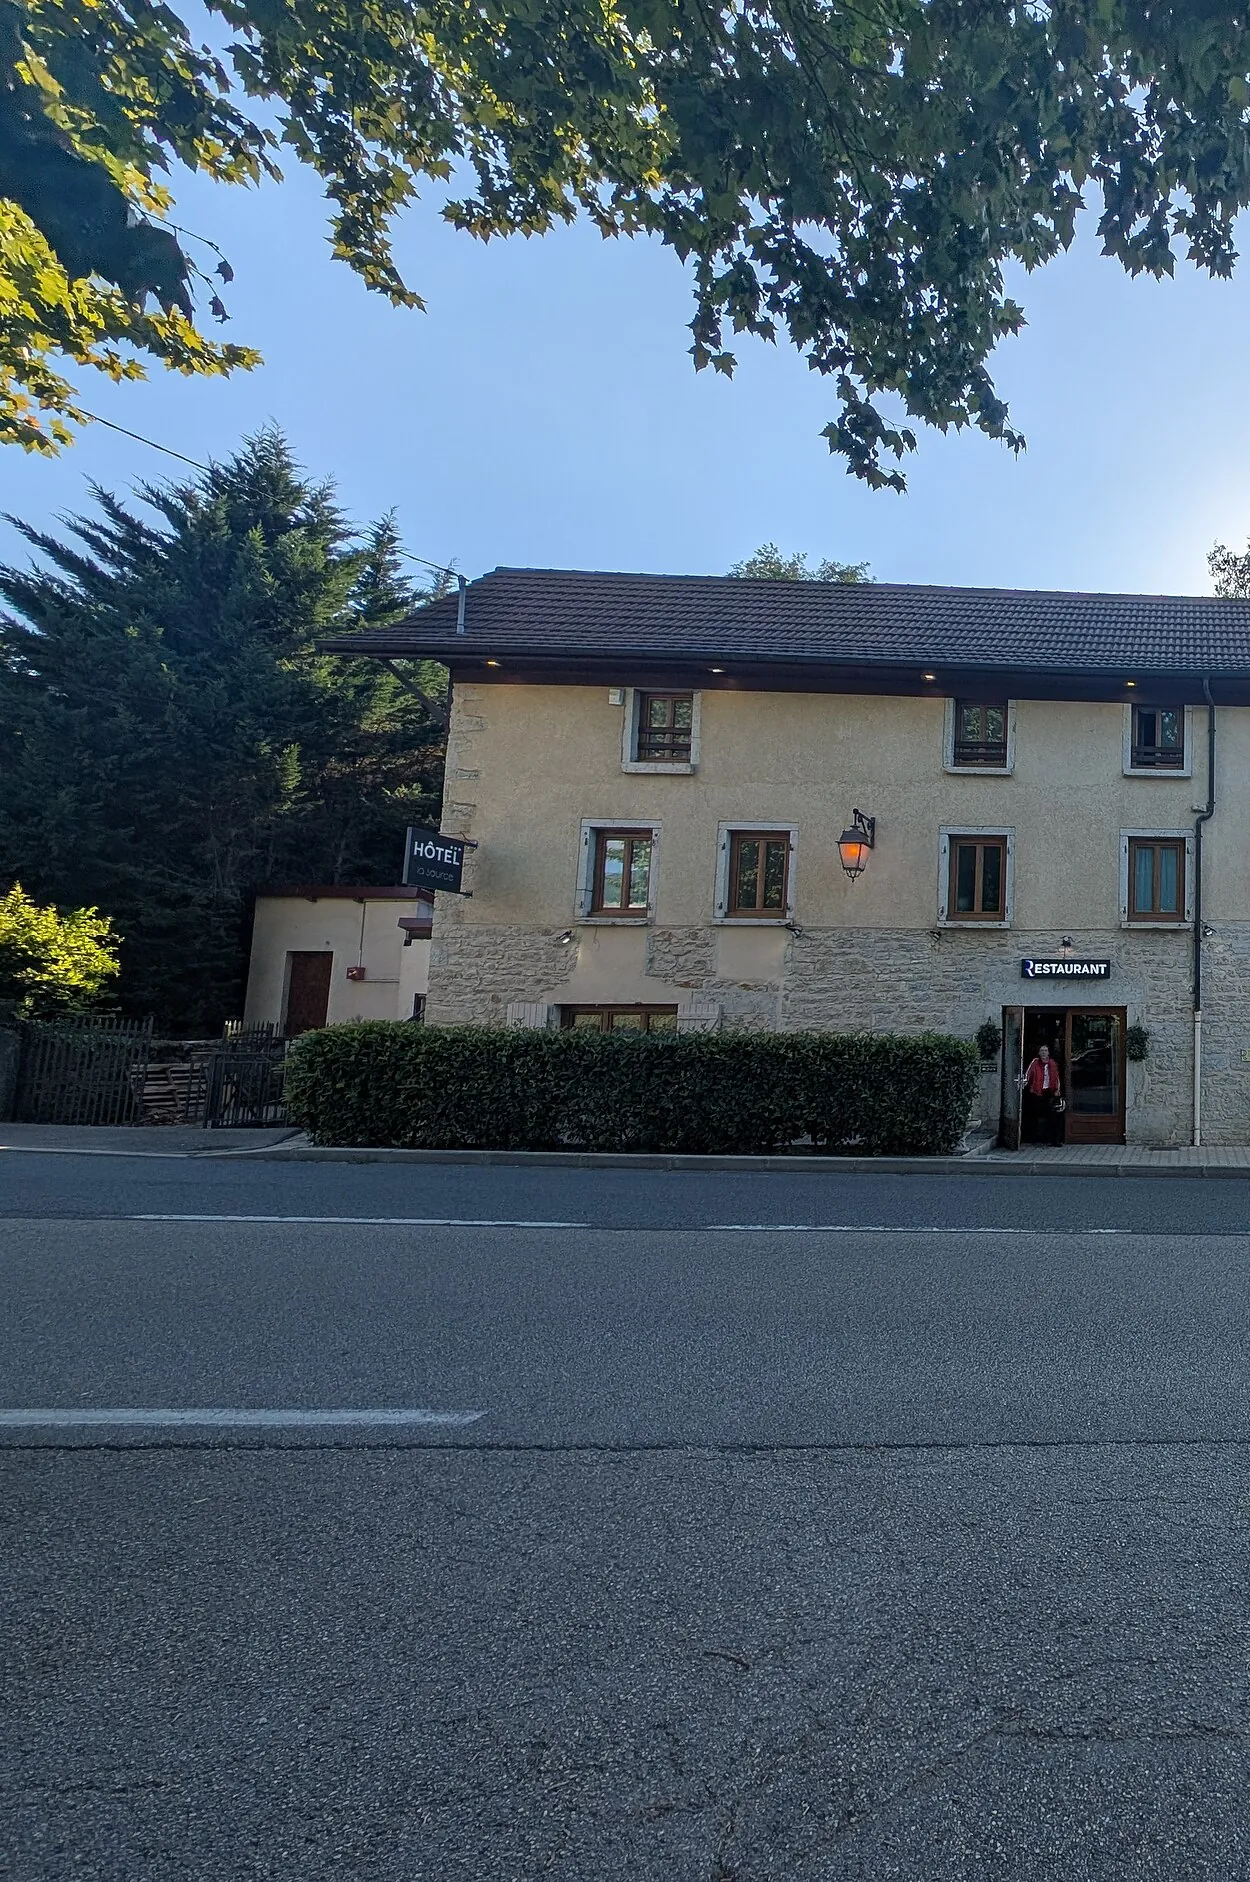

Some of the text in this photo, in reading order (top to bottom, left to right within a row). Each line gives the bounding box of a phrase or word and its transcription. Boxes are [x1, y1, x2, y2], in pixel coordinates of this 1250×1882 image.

[413, 841, 461, 866] HÔTEL
[425, 868, 454, 882] source
[1024, 960, 1107, 977] RESTAURANT
